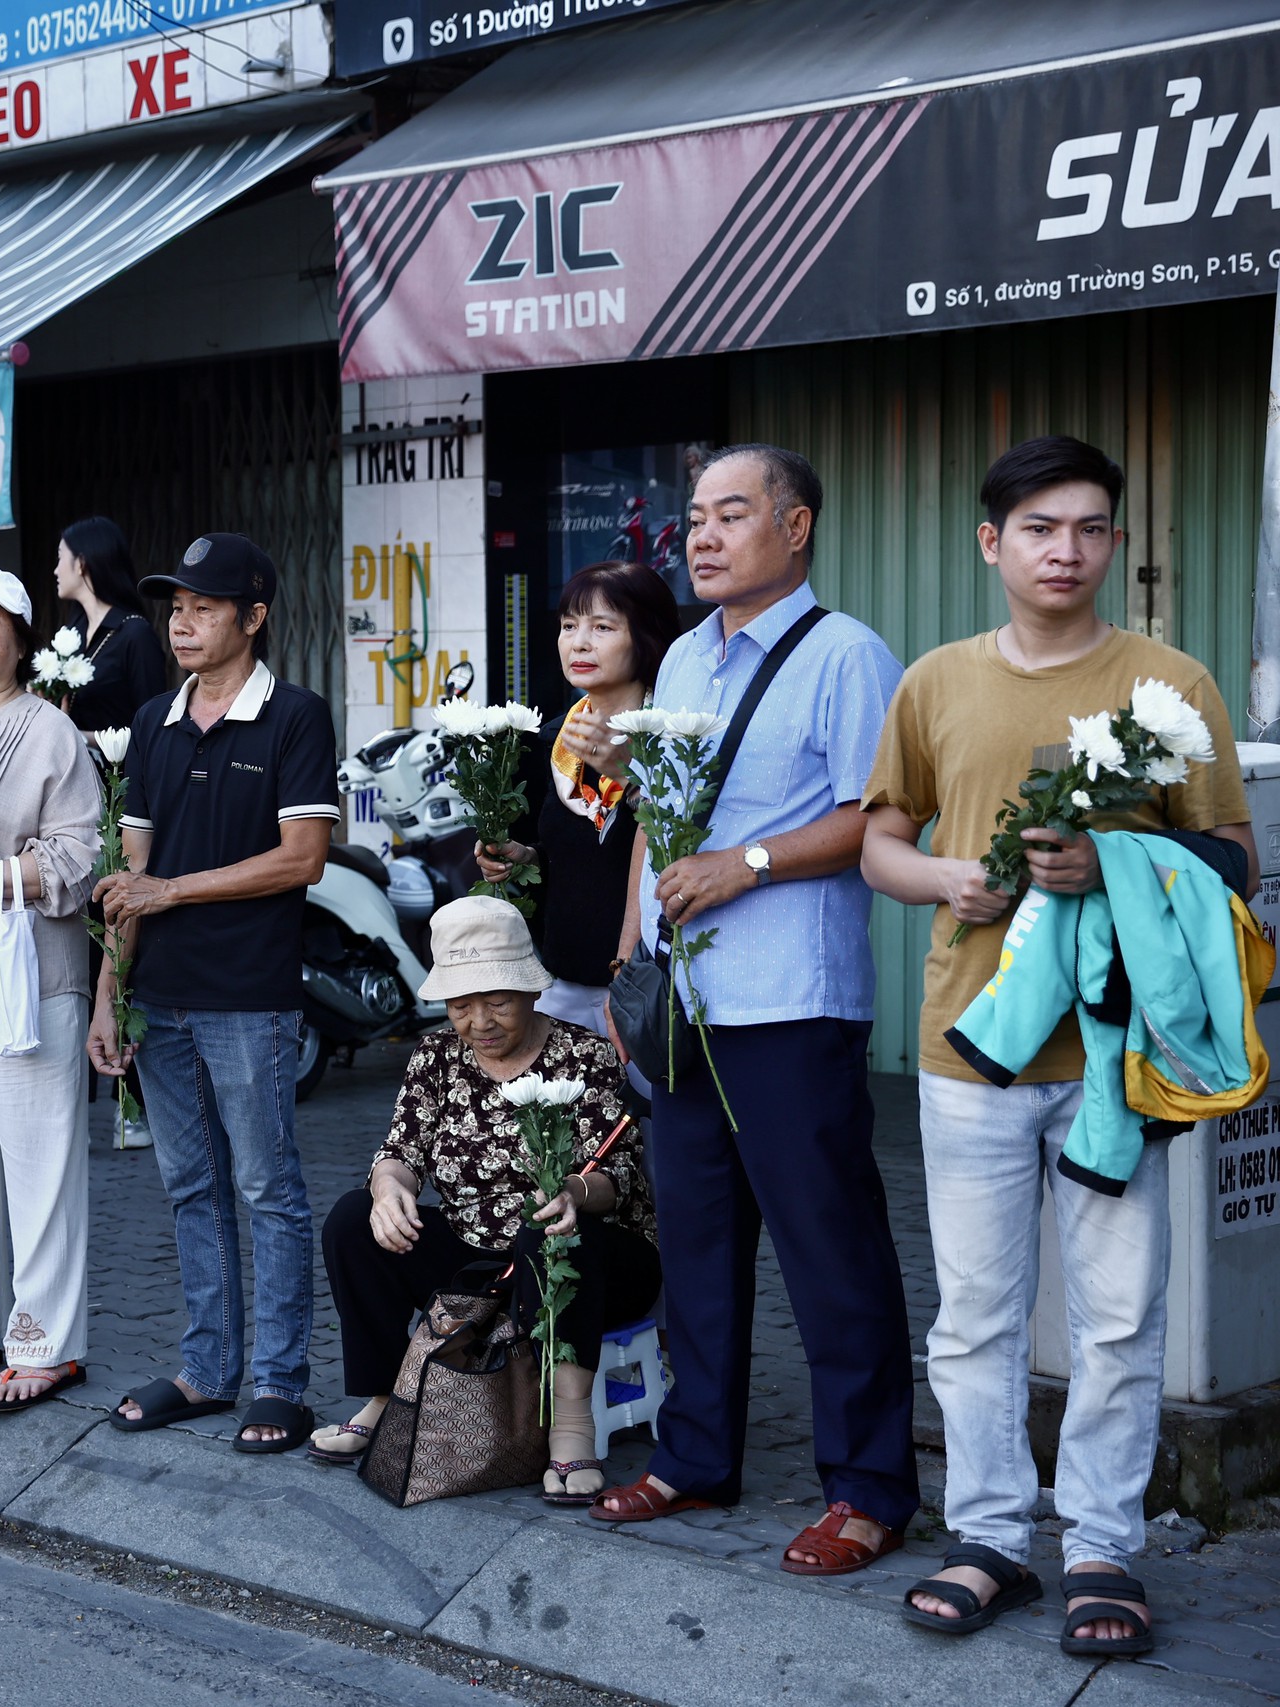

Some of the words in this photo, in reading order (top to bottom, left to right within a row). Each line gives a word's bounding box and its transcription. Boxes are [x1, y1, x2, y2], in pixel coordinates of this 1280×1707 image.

[429, 12, 458, 46] Số
[462, 14, 472, 39] 1
[476, 1, 554, 36] Đường
[128, 48, 192, 121] XE
[1036, 76, 1280, 242] SỬA
[464, 181, 624, 286] ZIC
[945, 284, 969, 307] Số
[973, 284, 989, 308] 1,
[994, 279, 1062, 301] đường
[1067, 268, 1145, 294] Trường
[1151, 263, 1200, 284] Sơn,
[1206, 252, 1260, 277] P.15,
[464, 287, 625, 338] STATION
[424, 392, 470, 480] TRÍ
[1219, 1155, 1236, 1195] LH:
[1240, 1148, 1266, 1191] 0583
